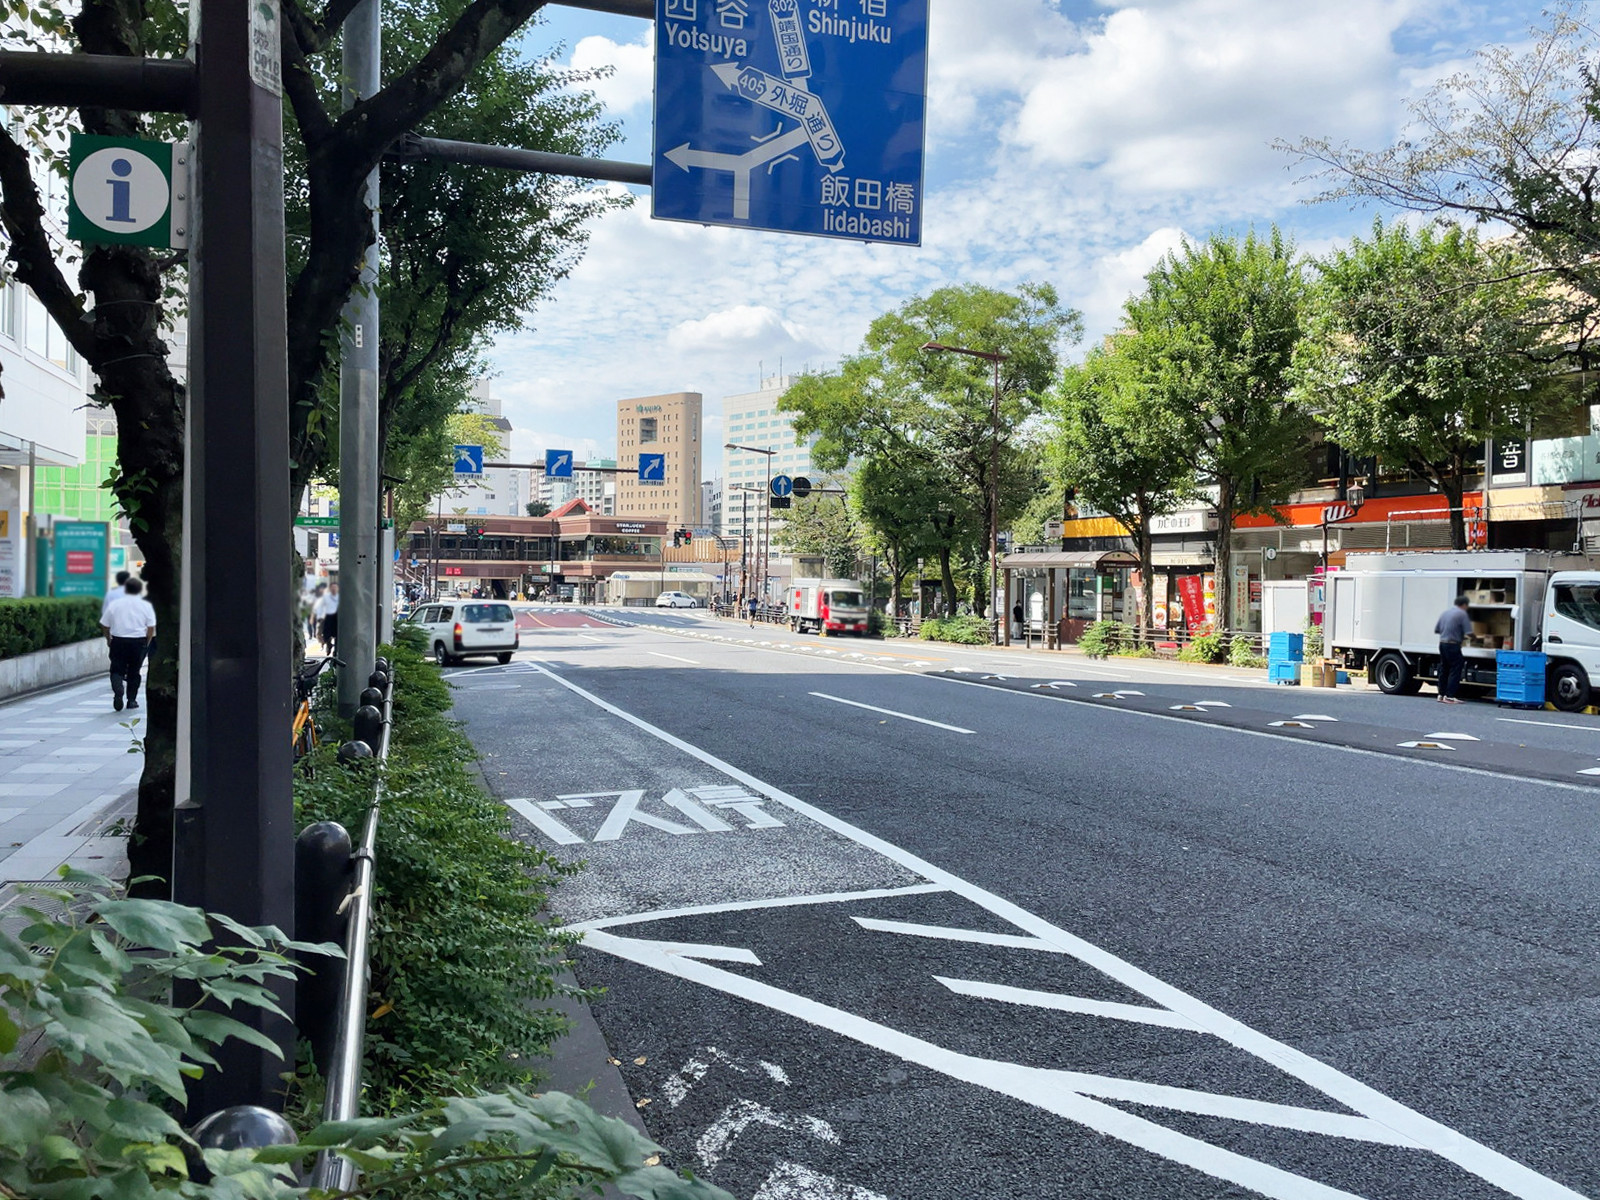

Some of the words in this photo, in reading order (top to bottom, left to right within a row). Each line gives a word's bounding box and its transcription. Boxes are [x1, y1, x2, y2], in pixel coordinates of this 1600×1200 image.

[773, 0, 794, 12] 302
[664, 21, 747, 59] Yotsuya
[808, 9, 891, 44] Shinjuku
[779, 20, 803, 70] 靖国通り
[739, 74, 765, 95] 405
[770, 85, 835, 151] 外堀通り
[820, 173, 915, 215] 飯田橋
[823, 208, 910, 239] Iidabashi
